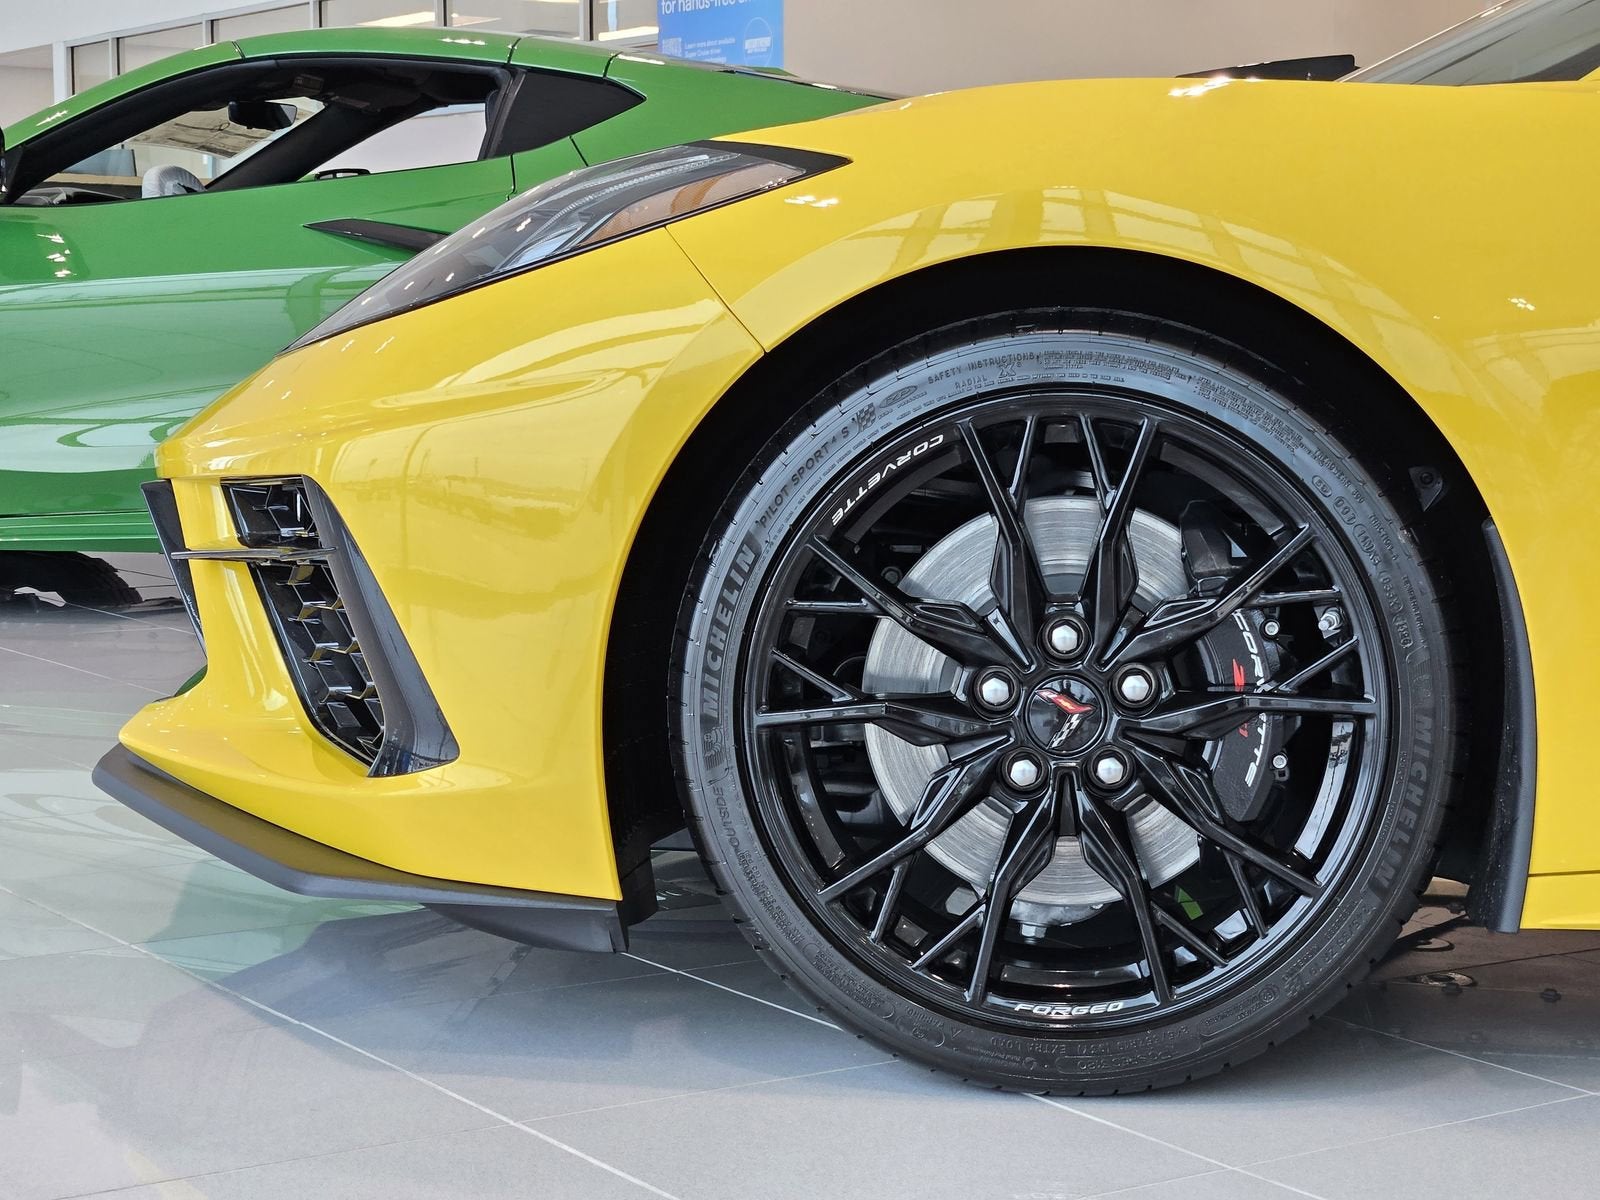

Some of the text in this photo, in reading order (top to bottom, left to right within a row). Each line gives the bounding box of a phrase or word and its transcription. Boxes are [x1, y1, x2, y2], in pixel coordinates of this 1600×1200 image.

[925, 364, 962, 385] SAFETY
[966, 351, 1034, 372] INSTRUCTIONS
[756, 483, 793, 529] PILOT
[788, 440, 834, 487] SPORT
[837, 424, 852, 439] S
[832, 434, 943, 526] CORVETTE
[703, 542, 758, 718] MICHELIN
[1372, 713, 1433, 888] MICHELIN
[1014, 1001, 1124, 1016] FORGED
